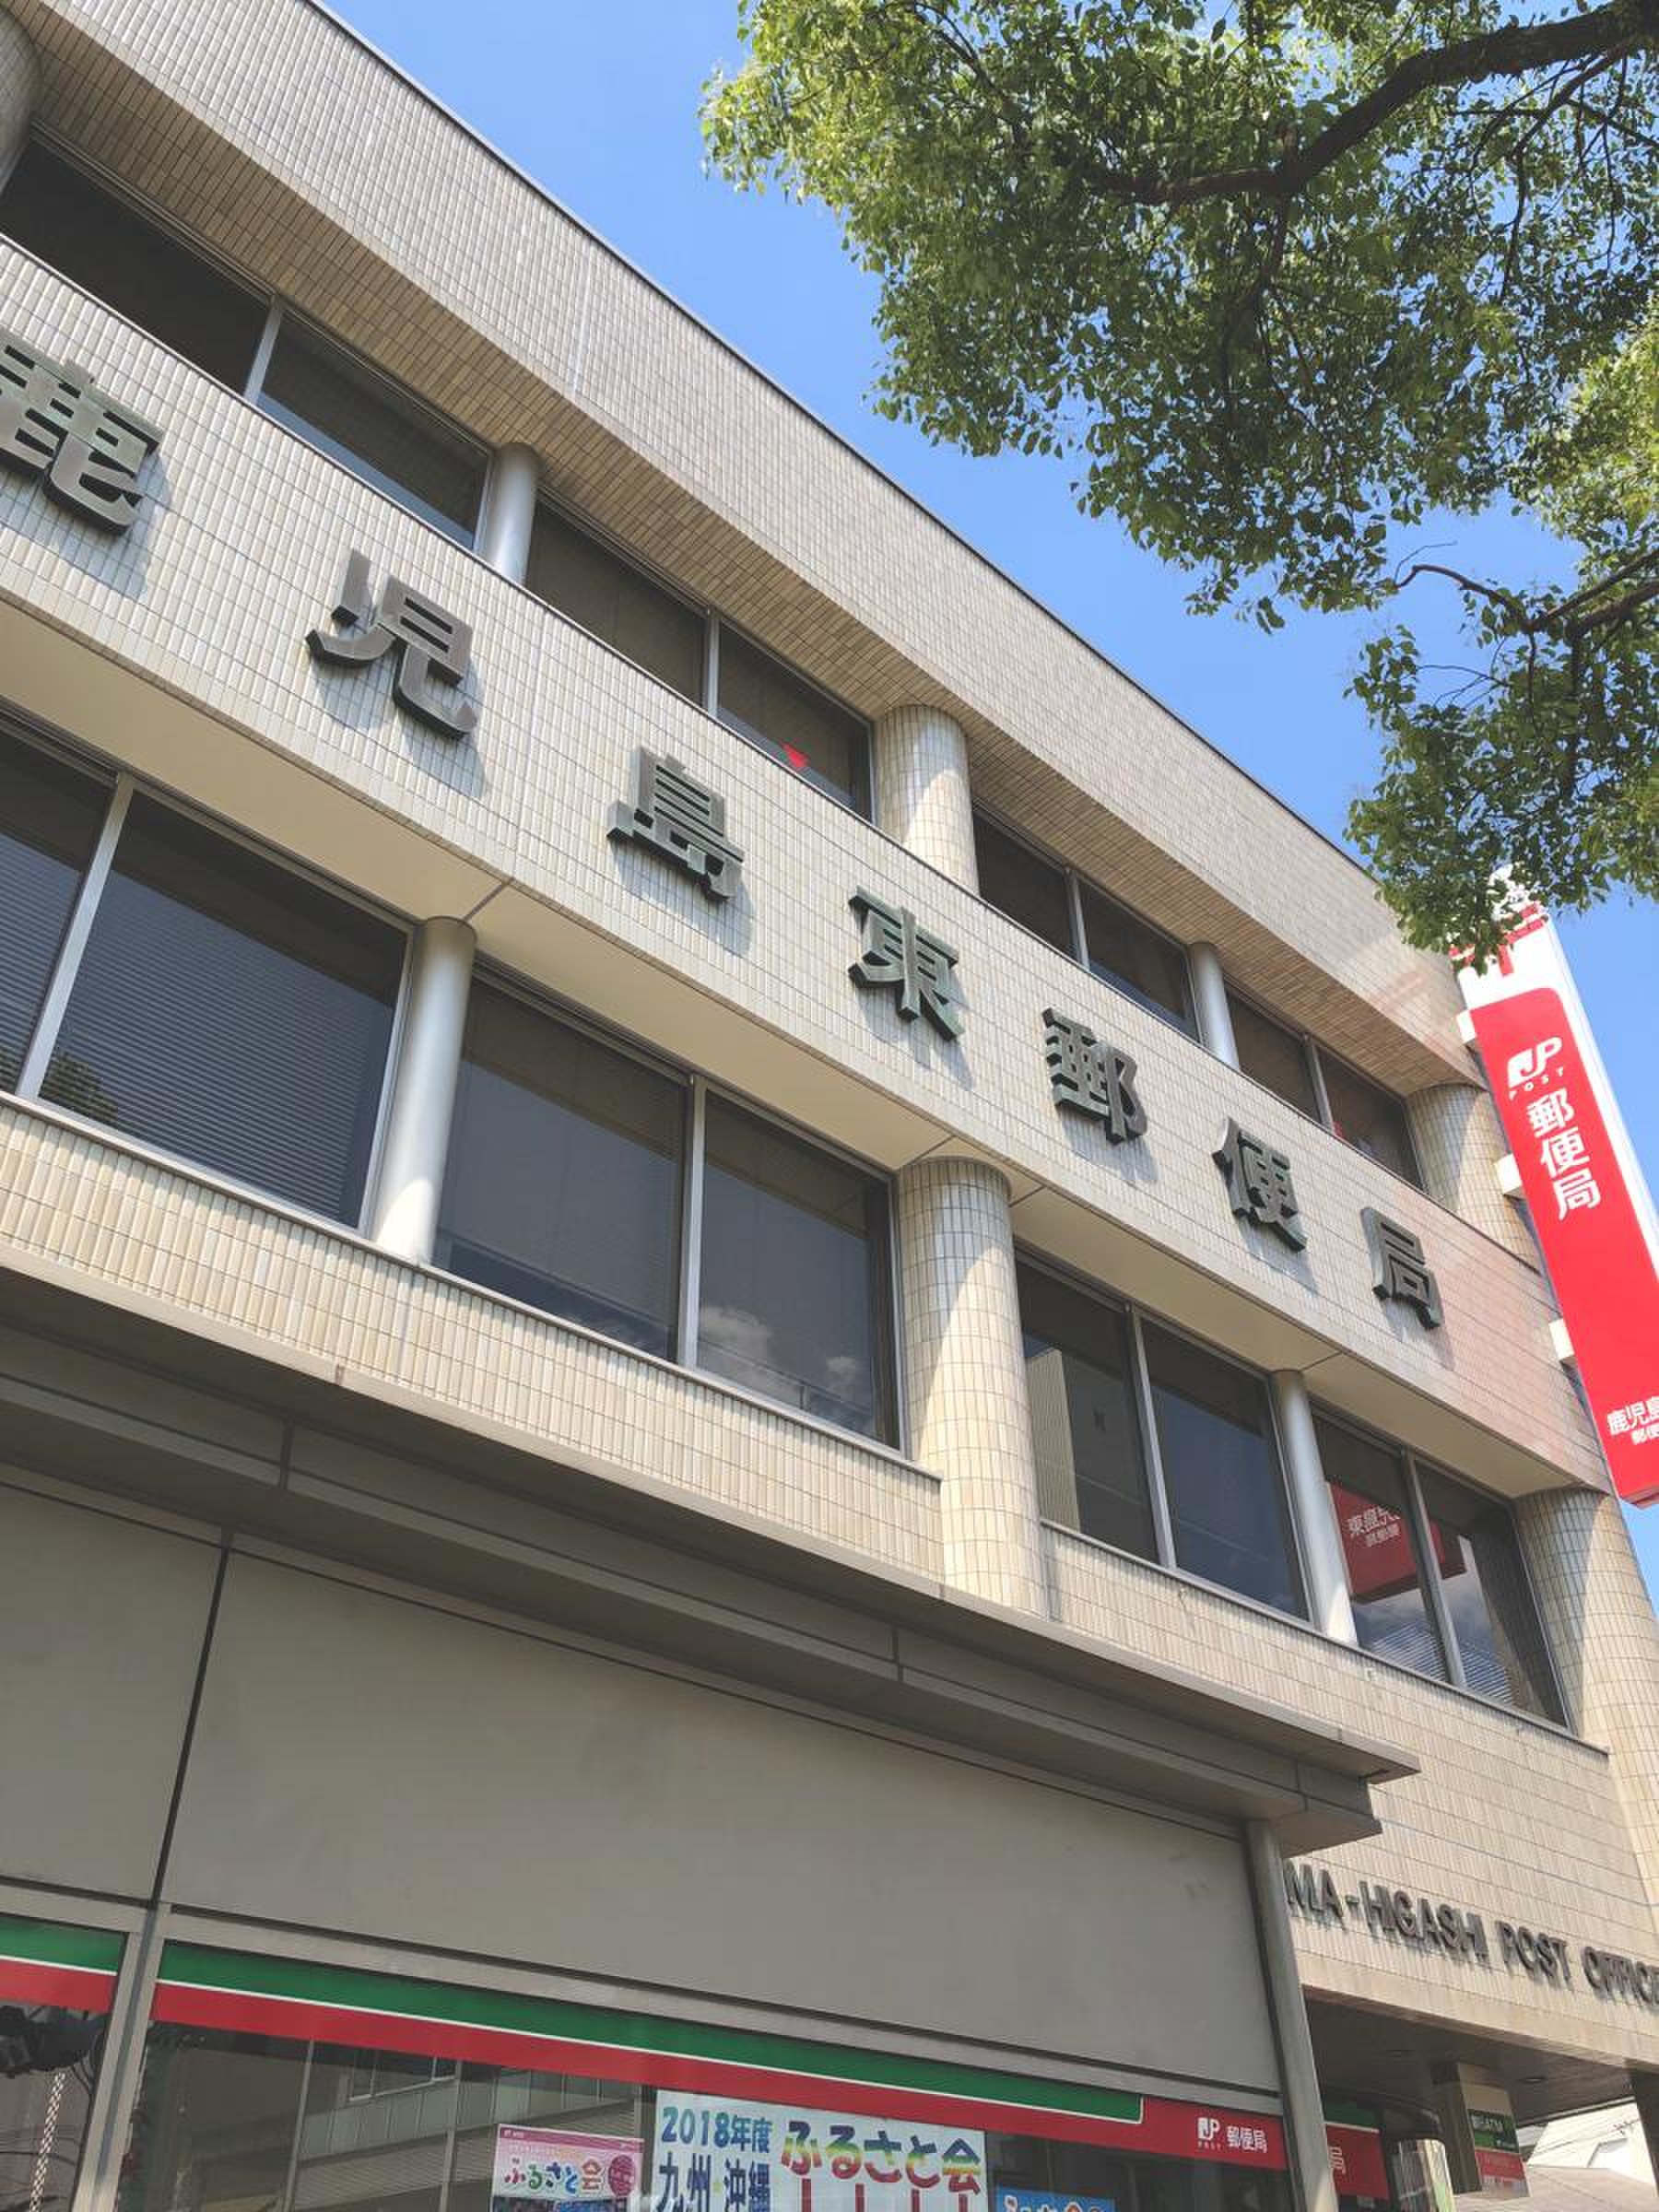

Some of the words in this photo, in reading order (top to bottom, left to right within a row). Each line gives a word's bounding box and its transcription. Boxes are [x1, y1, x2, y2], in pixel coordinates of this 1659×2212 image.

[1509, 1066, 1564, 1100] POST
[1526, 1087, 1602, 1221] 郵便局
[1496, 1921, 1570, 1982] POST
[661, 2106, 772, 2154] 2018年度
[1227, 2125, 1268, 2153] 郵便局
[504, 2158, 602, 2194] ふるさと会
[781, 2121, 982, 2195] ふるさと会
